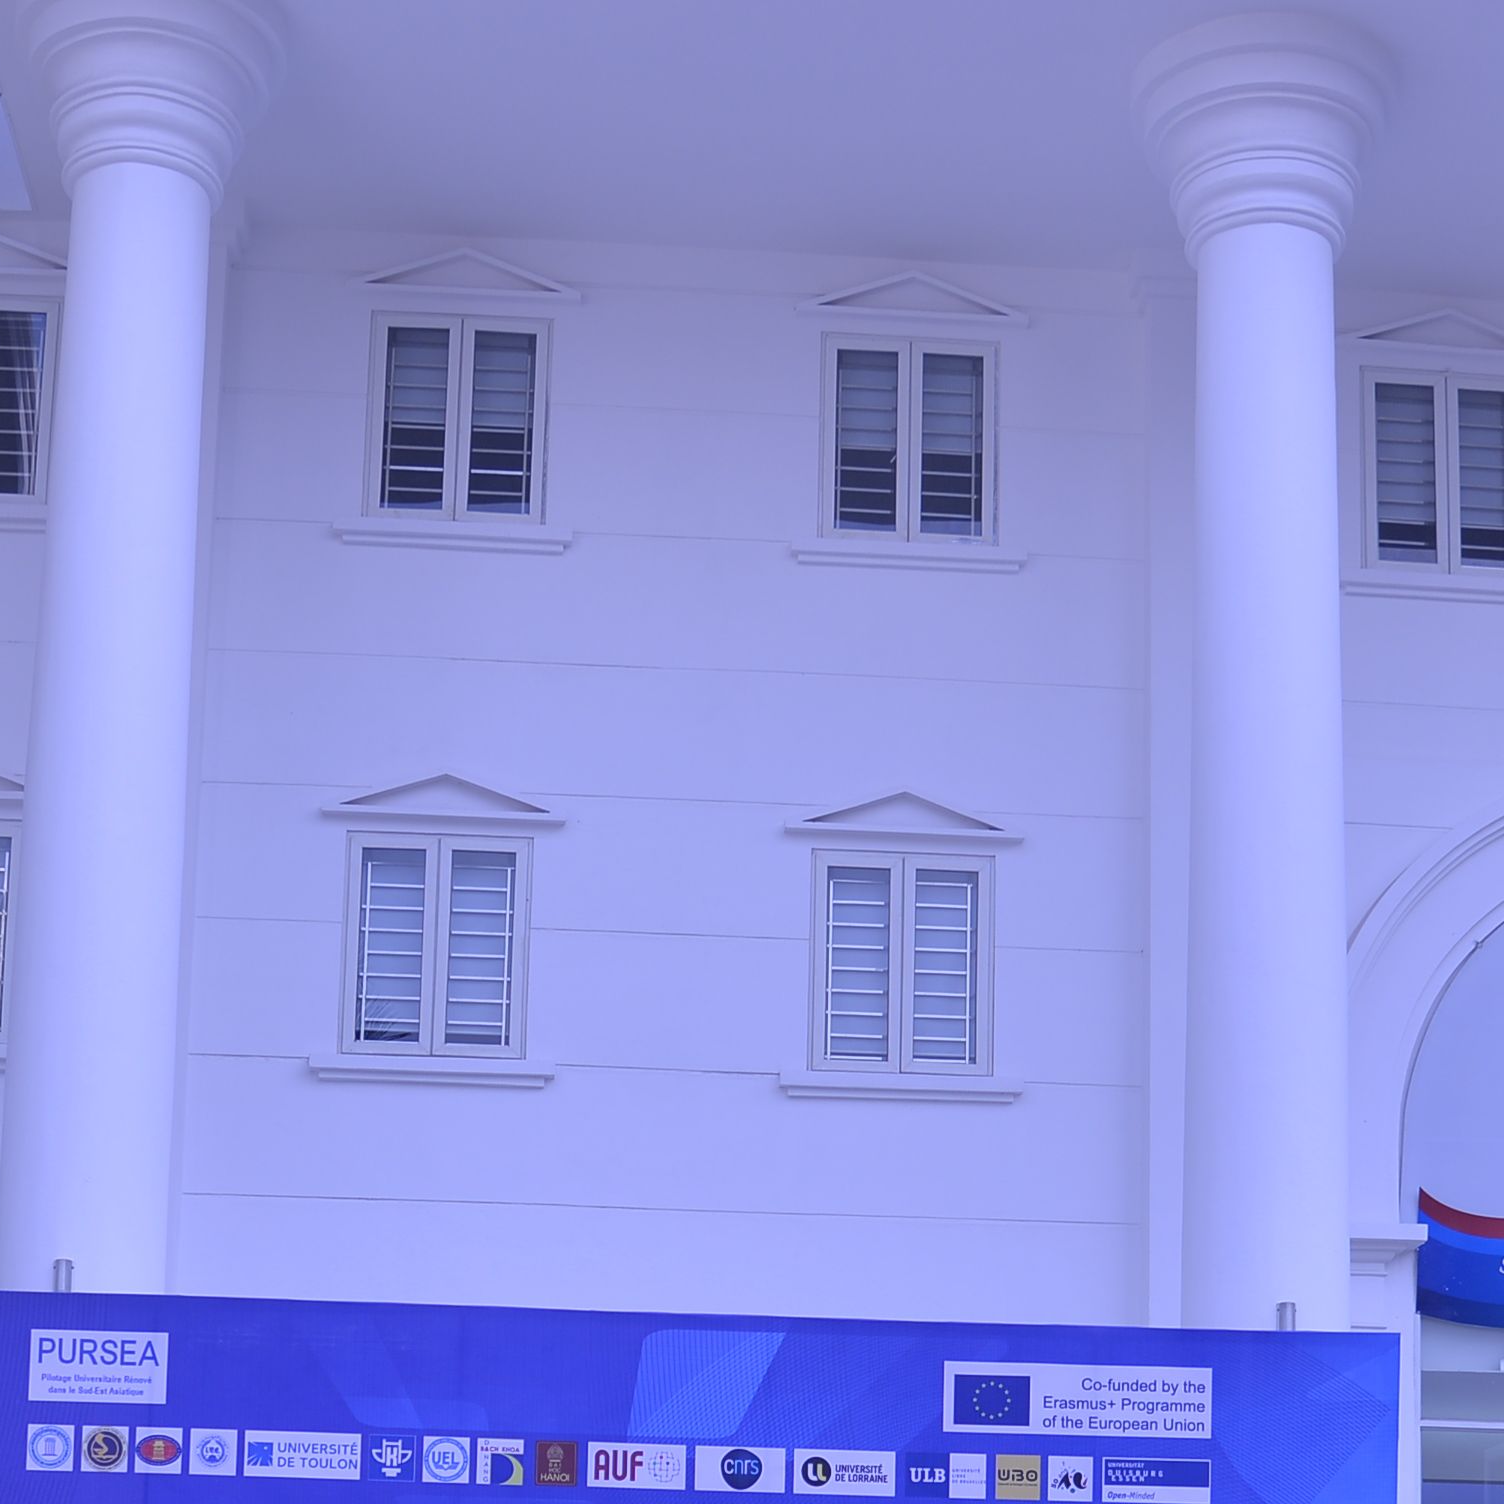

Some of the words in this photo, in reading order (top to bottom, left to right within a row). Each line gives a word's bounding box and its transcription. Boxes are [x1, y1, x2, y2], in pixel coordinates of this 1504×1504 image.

[38, 1337, 160, 1367] PURSEA
[69, 1386, 76, 1394] le
[1082, 1377, 1157, 1393] Co-funded
[1162, 1380, 1179, 1396] by
[1184, 1380, 1206, 1394] the
[1043, 1395, 1116, 1411] Erasmus+
[1121, 1398, 1206, 1415] Programme
[1042, 1415, 1058, 1428] of
[1061, 1416, 1083, 1429] the
[1088, 1416, 1158, 1432] European
[1163, 1418, 1205, 1432] Union
[278, 1442, 358, 1456] UNIVERSITÉ
[277, 1457, 295, 1468] DE
[300, 1458, 358, 1470] TOULON
[431, 1451, 460, 1465] UEL
[594, 1449, 644, 1481] AUF
[835, 1464, 883, 1474] UNIVERSITÉ
[909, 1467, 946, 1483] ULB
[835, 1474, 845, 1482] DE
[848, 1474, 888, 1483] LORRAINE
